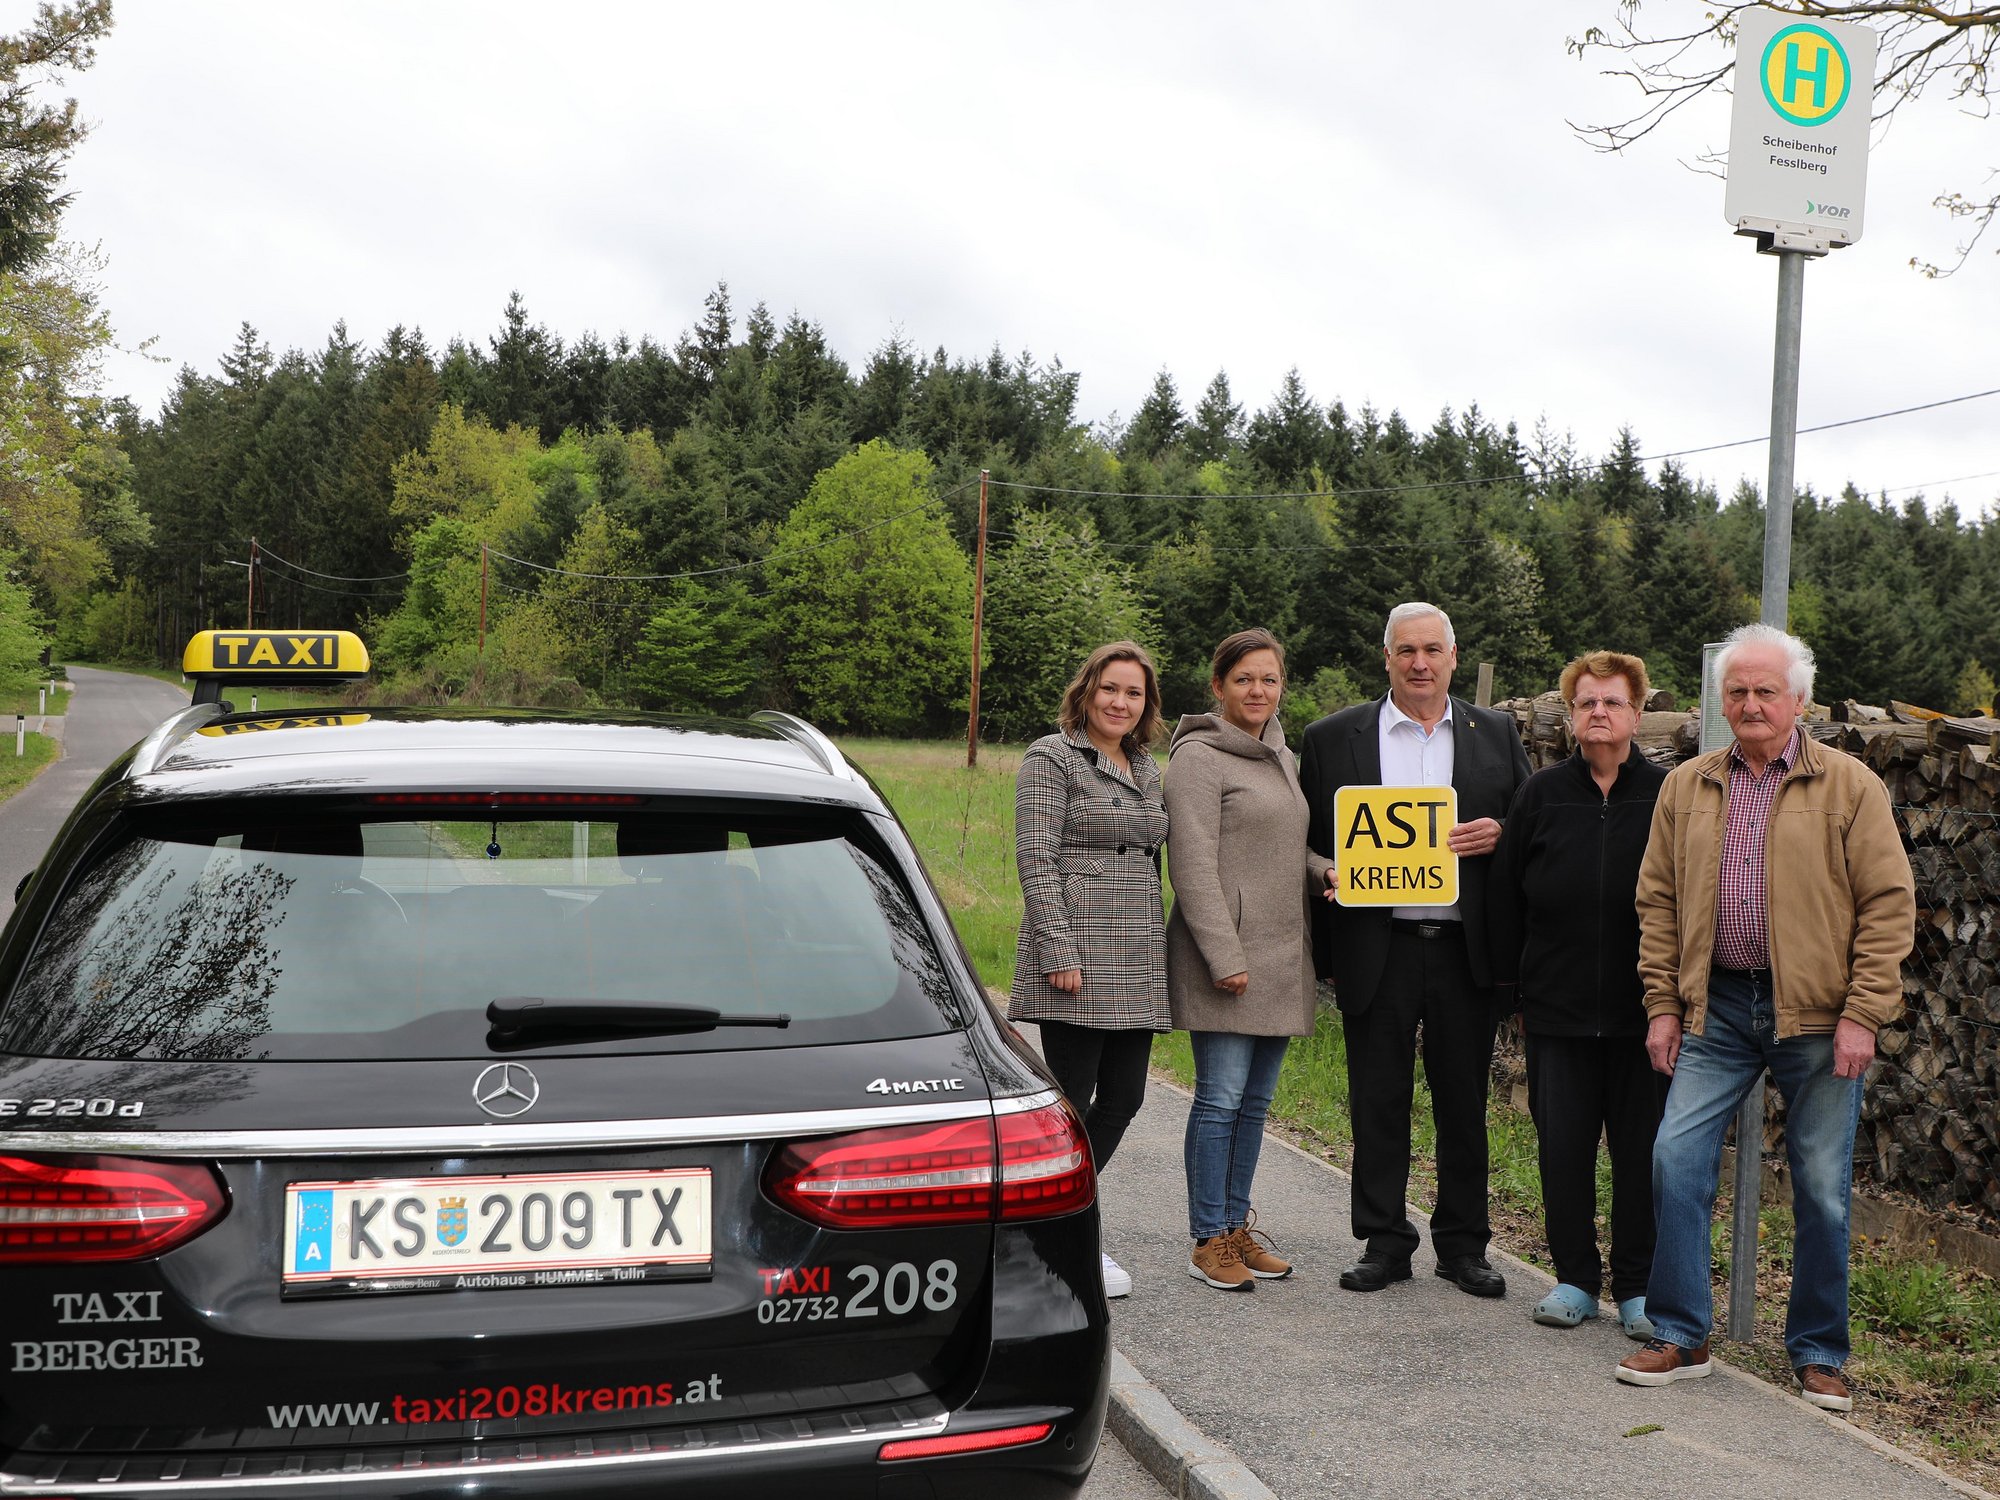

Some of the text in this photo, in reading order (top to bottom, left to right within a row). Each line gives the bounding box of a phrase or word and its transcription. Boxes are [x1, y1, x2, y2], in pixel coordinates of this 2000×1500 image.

[1783, 42, 1829, 108] H
[1762, 135, 1838, 156] Scheibenhof
[1769, 155, 1828, 175] Fesslberg
[1816, 203, 1851, 219] VOR
[219, 637, 333, 665] TAXI
[1345, 801, 1448, 849] AST
[1350, 866, 1444, 890] KREMS
[866, 1078, 965, 1095] 4MATIC
[350, 1187, 683, 1260] KS 209 TX
[304, 1241, 322, 1261] A
[455, 1267, 646, 1288] Autohaus HUMMEL Tulln
[757, 1266, 831, 1296] TAXI
[757, 1259, 958, 1324] 02732 208
[53, 1291, 163, 1324] TAXI
[11, 1337, 204, 1372] BERGER
[266, 1373, 723, 1429] www.taxi208krems.at
